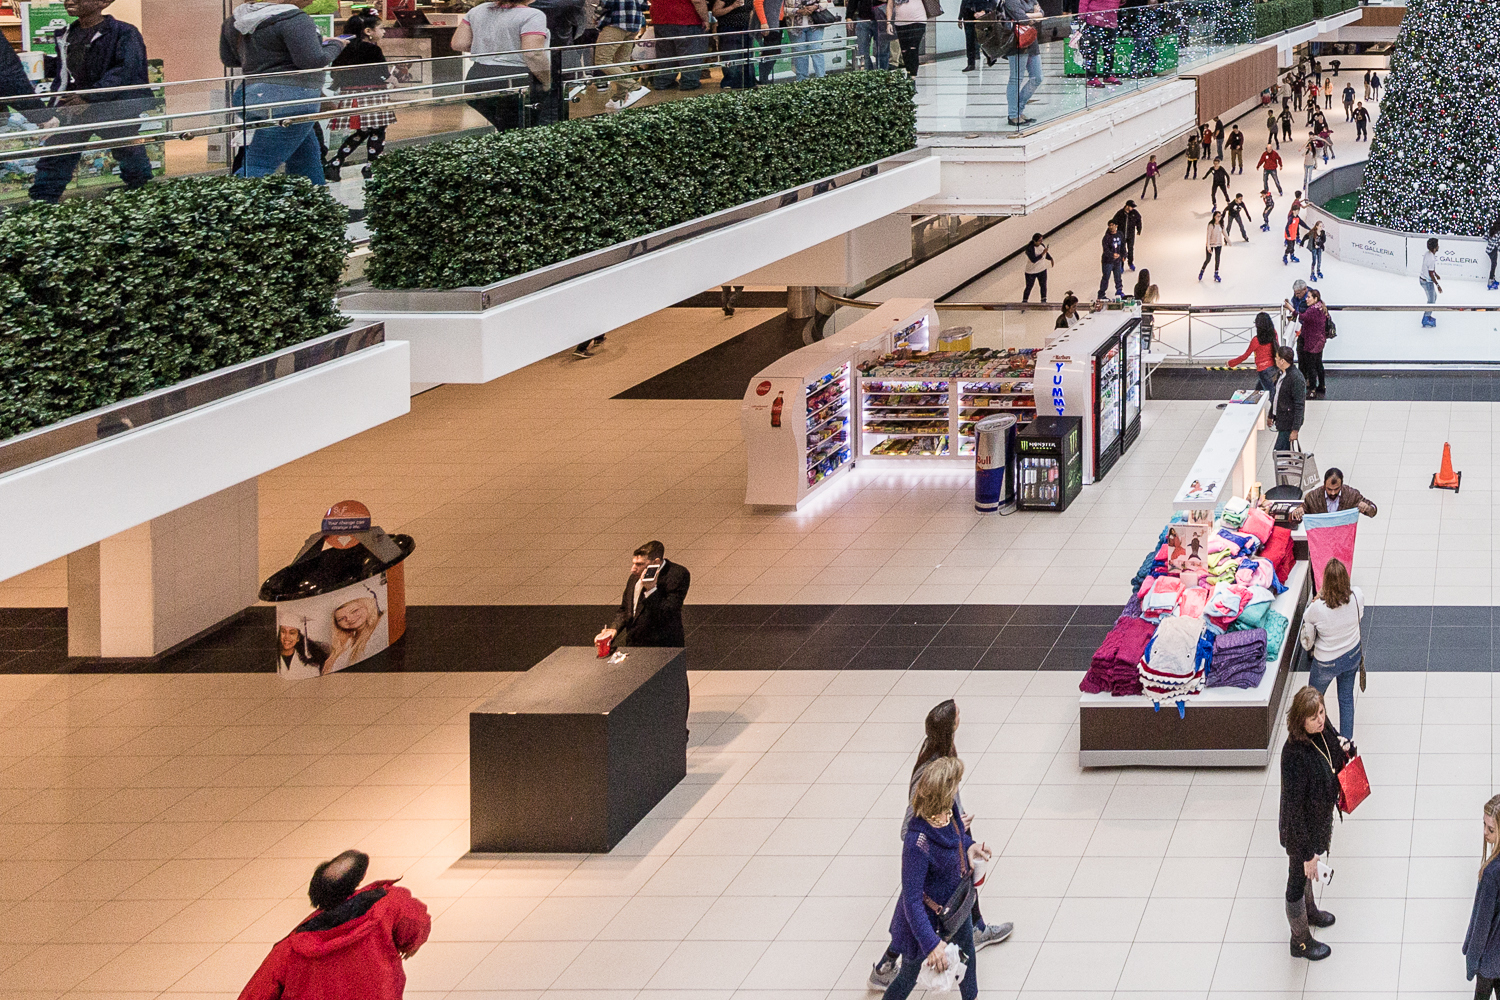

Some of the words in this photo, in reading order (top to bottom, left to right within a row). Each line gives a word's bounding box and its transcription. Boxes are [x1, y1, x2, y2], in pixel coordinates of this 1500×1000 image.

[1351, 241, 1364, 250] THE
[1364, 244, 1394, 256] GALLERIA
[1439, 256, 1478, 264] GALLERIA
[1051, 362, 1065, 416] YUMMY
[977, 455, 991, 465] Bull
